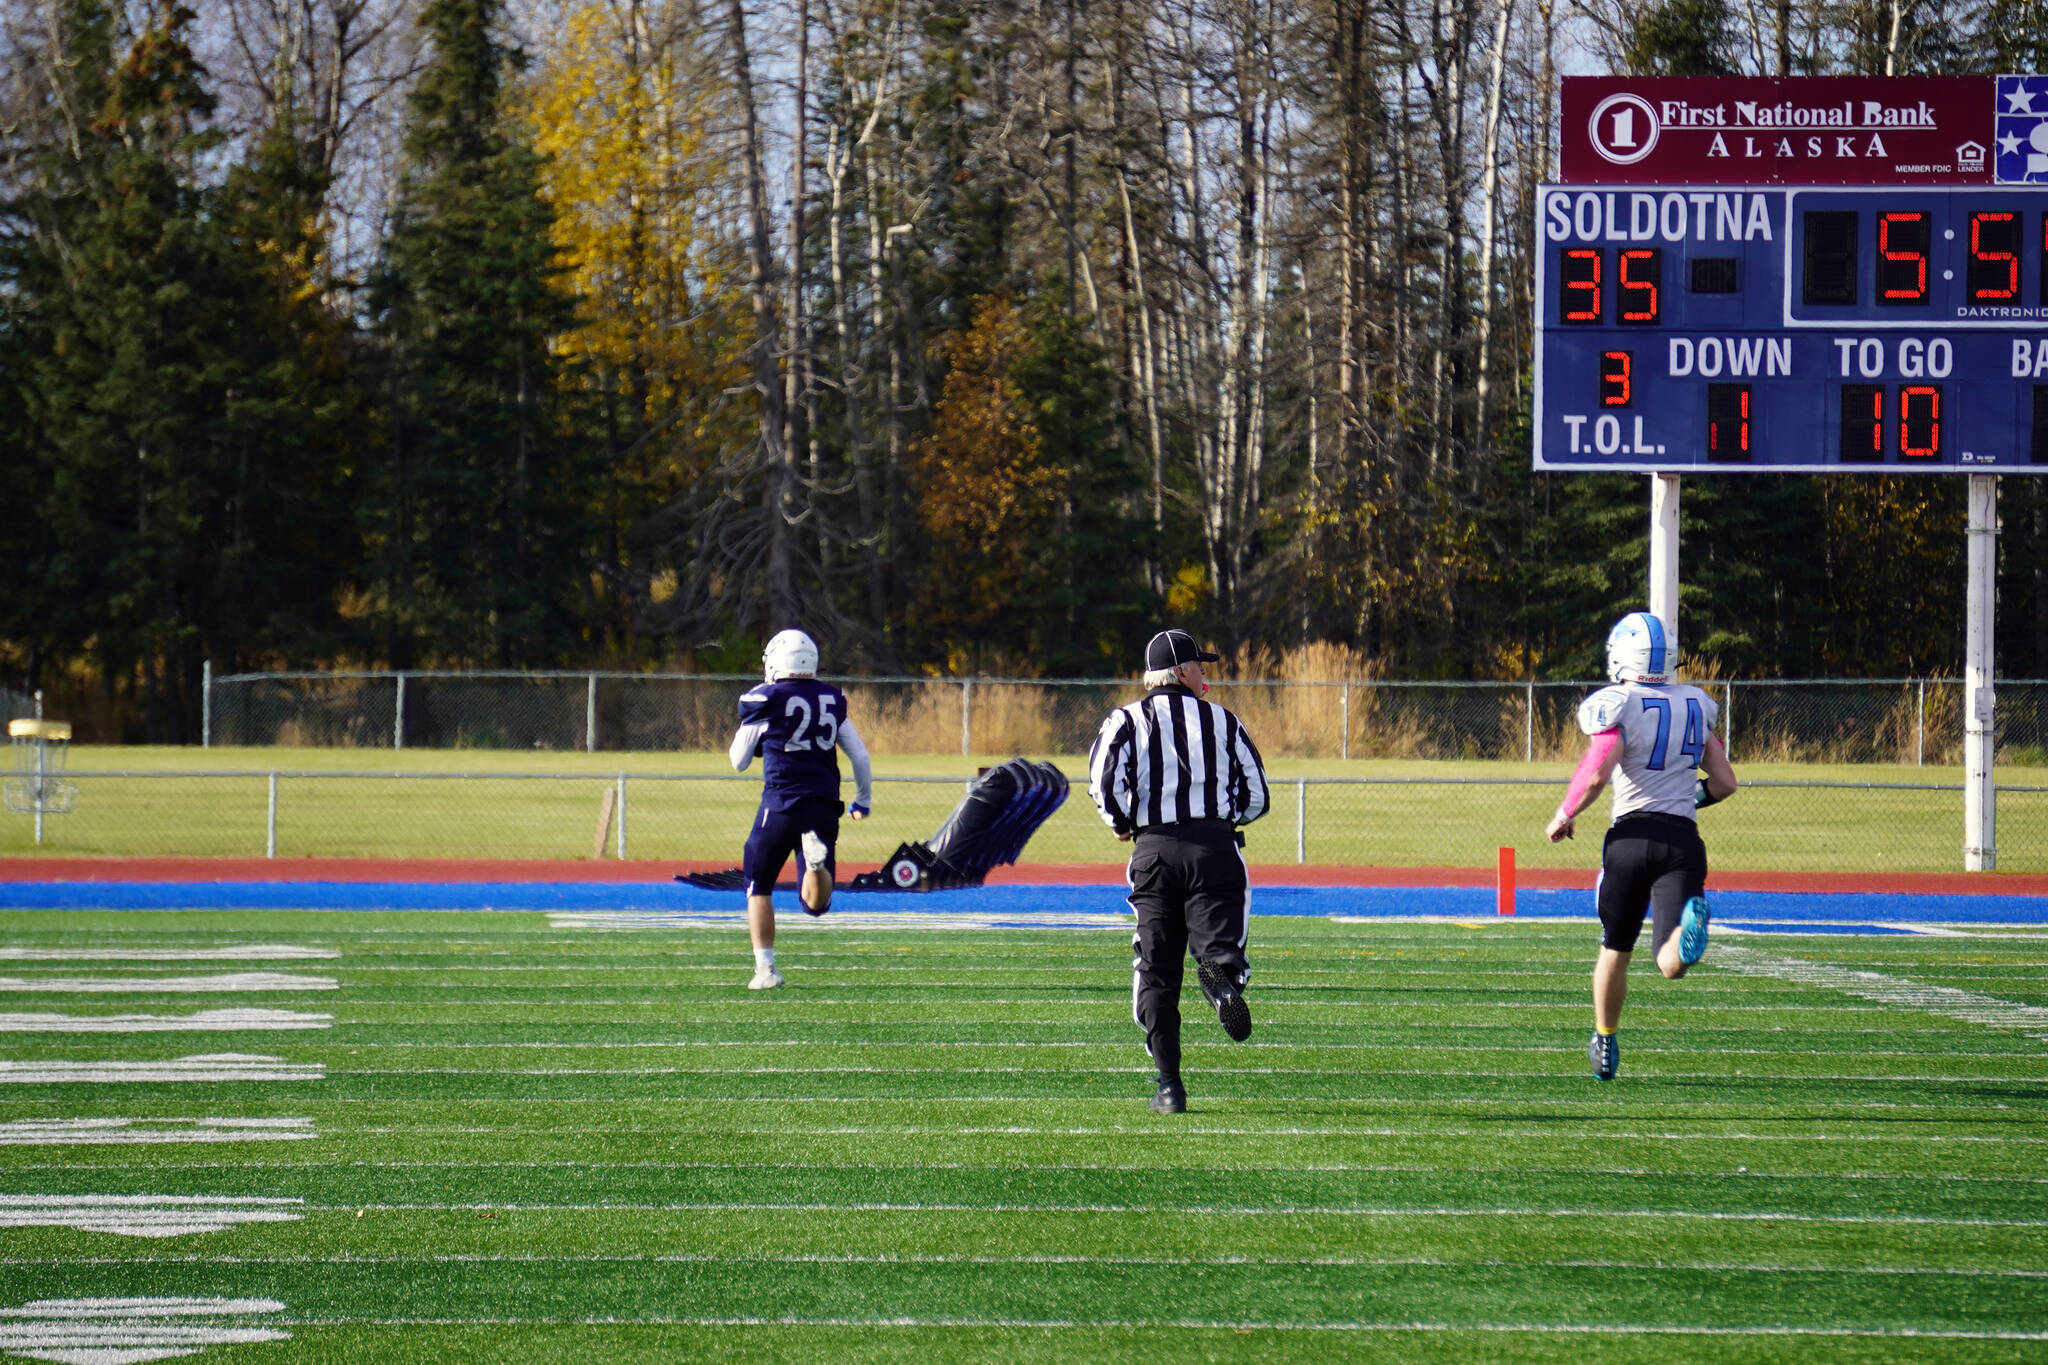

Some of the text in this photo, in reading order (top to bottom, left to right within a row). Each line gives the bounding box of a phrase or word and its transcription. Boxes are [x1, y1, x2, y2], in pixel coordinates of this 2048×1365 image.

[1661, 101, 1936, 126] First National Bank
[1707, 131, 1888, 157] ALASKA
[1895, 164, 1952, 173] MEMBER FDIC
[1957, 165, 1985, 173] LENDER
[1546, 192, 1773, 242] SOLDOTNA
[1566, 250, 1657, 320] 35
[1605, 351, 1630, 405] 3
[1669, 337, 1791, 377] DOWN
[1834, 337, 1953, 378] TO GO
[1563, 415, 1666, 454] T.O.L.
[1740, 391, 1748, 451] 1
[1874, 386, 1939, 456] 10
[784, 694, 837, 753] 25
[1642, 698, 1705, 770] 74
